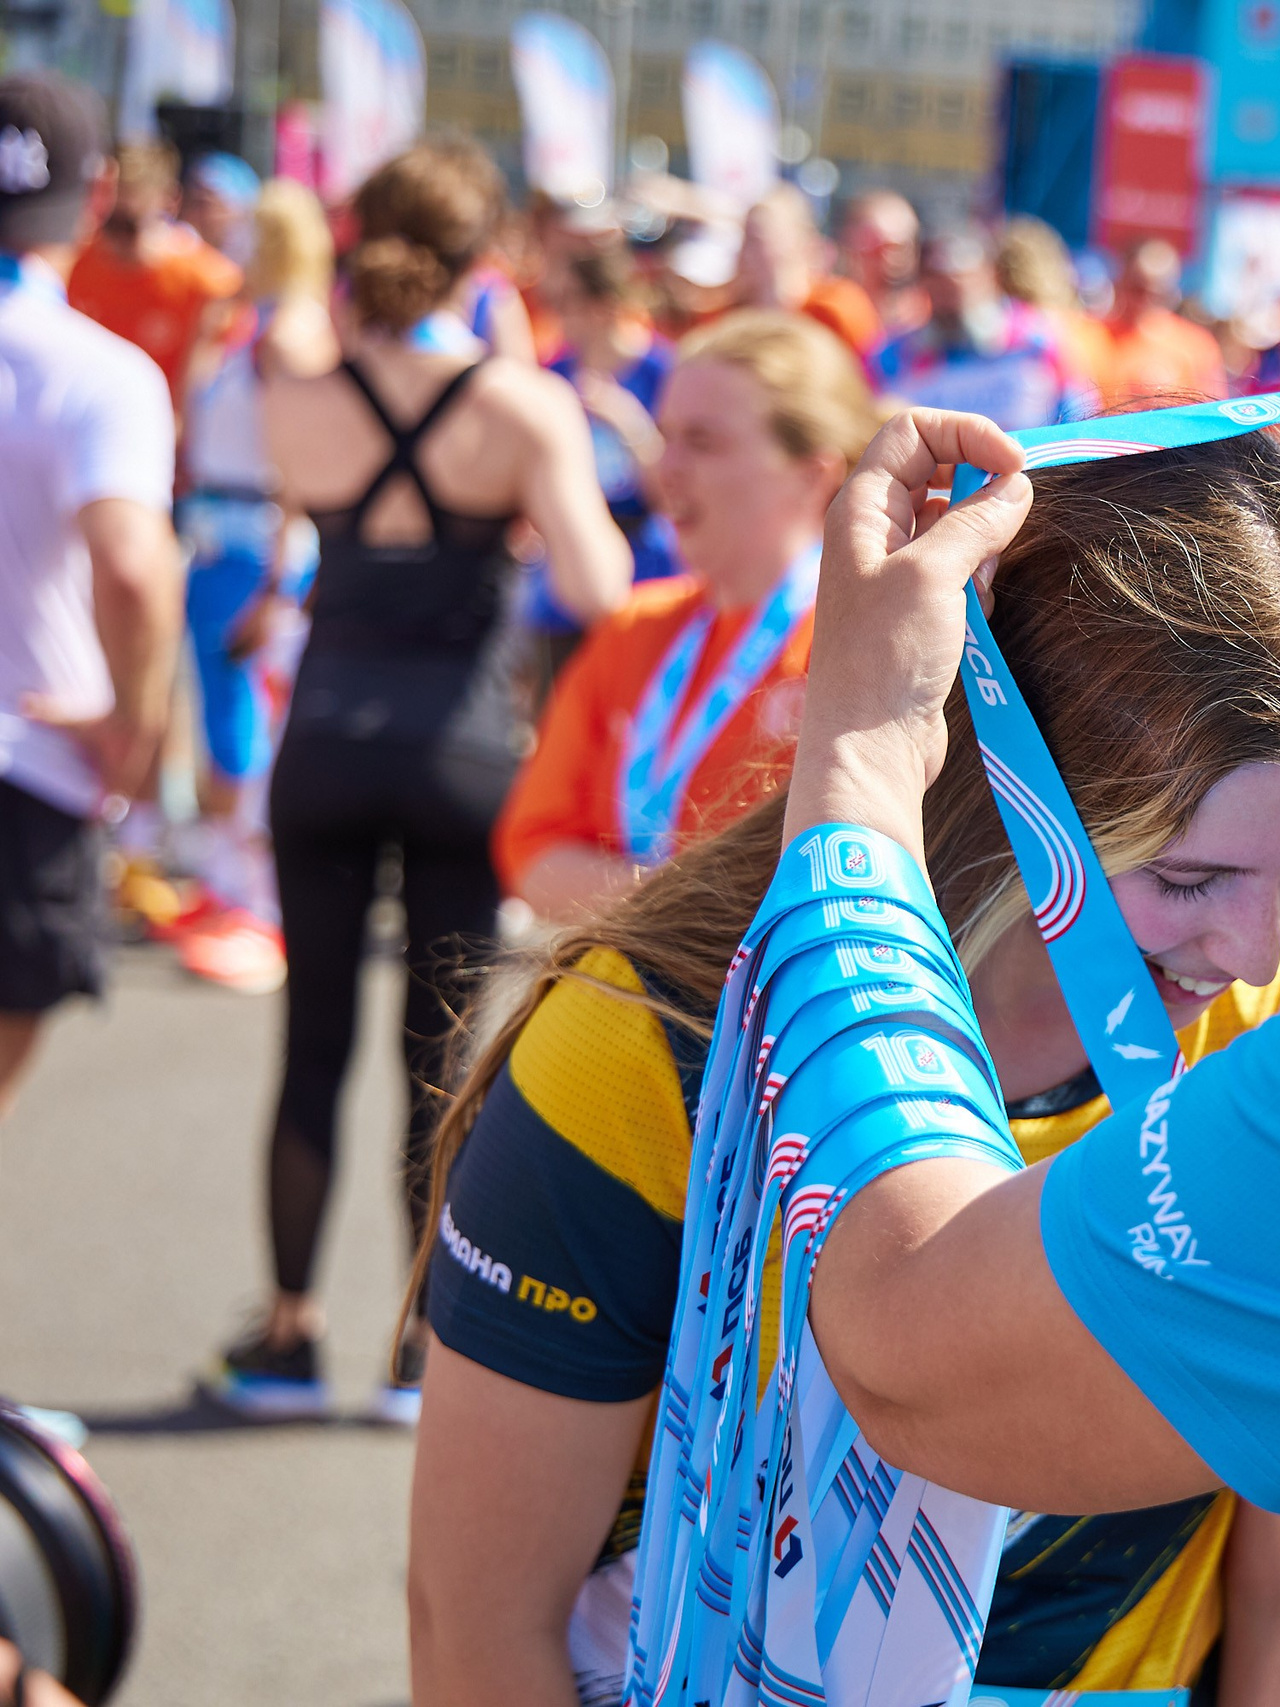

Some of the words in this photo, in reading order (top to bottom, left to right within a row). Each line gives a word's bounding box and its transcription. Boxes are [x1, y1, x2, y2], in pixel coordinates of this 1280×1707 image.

[799, 830, 887, 892] 10
[860, 1029, 958, 1086] 10
[516, 1274, 598, 1324] ПРО
[721, 1225, 752, 1340] ПСБ
